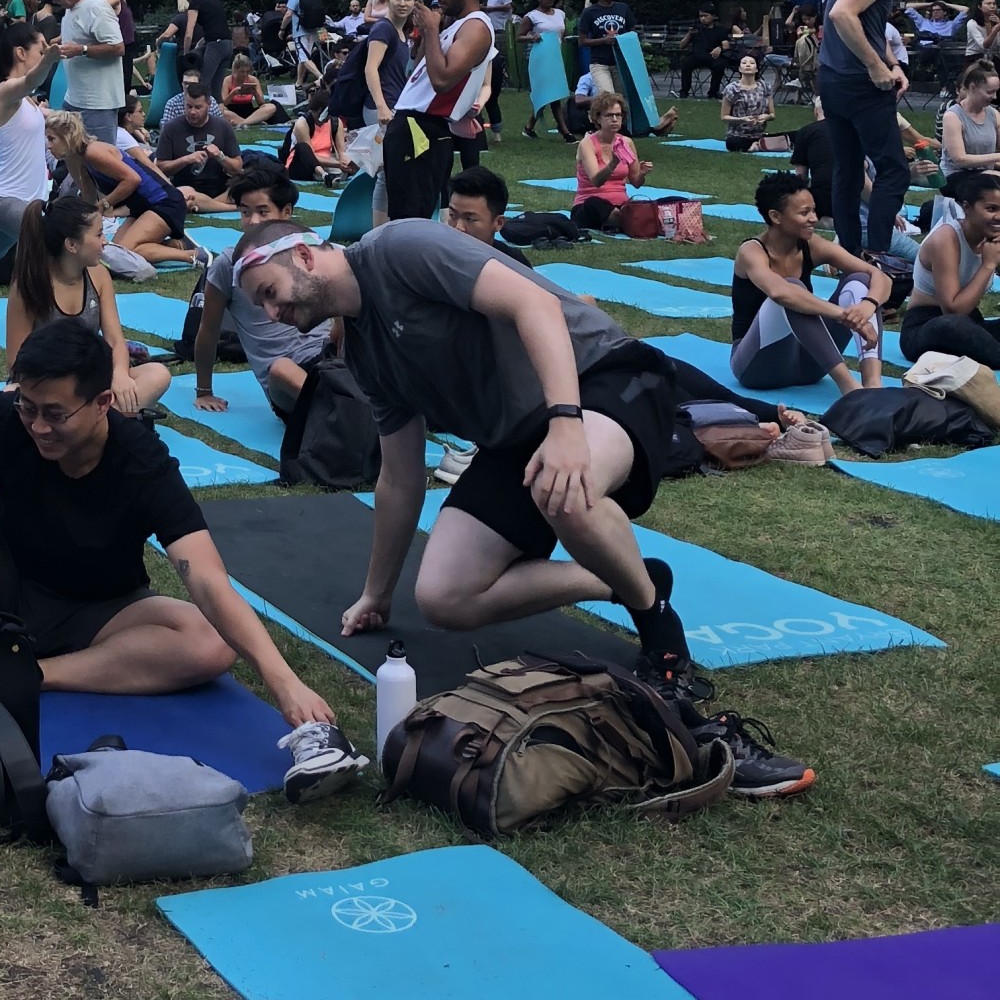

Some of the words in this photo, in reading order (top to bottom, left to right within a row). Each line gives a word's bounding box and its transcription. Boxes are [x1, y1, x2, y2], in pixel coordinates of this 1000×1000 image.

[593, 14, 626, 26] DISCOVERY
[685, 612, 888, 644] YOGA
[295, 877, 390, 899] GAIAM
